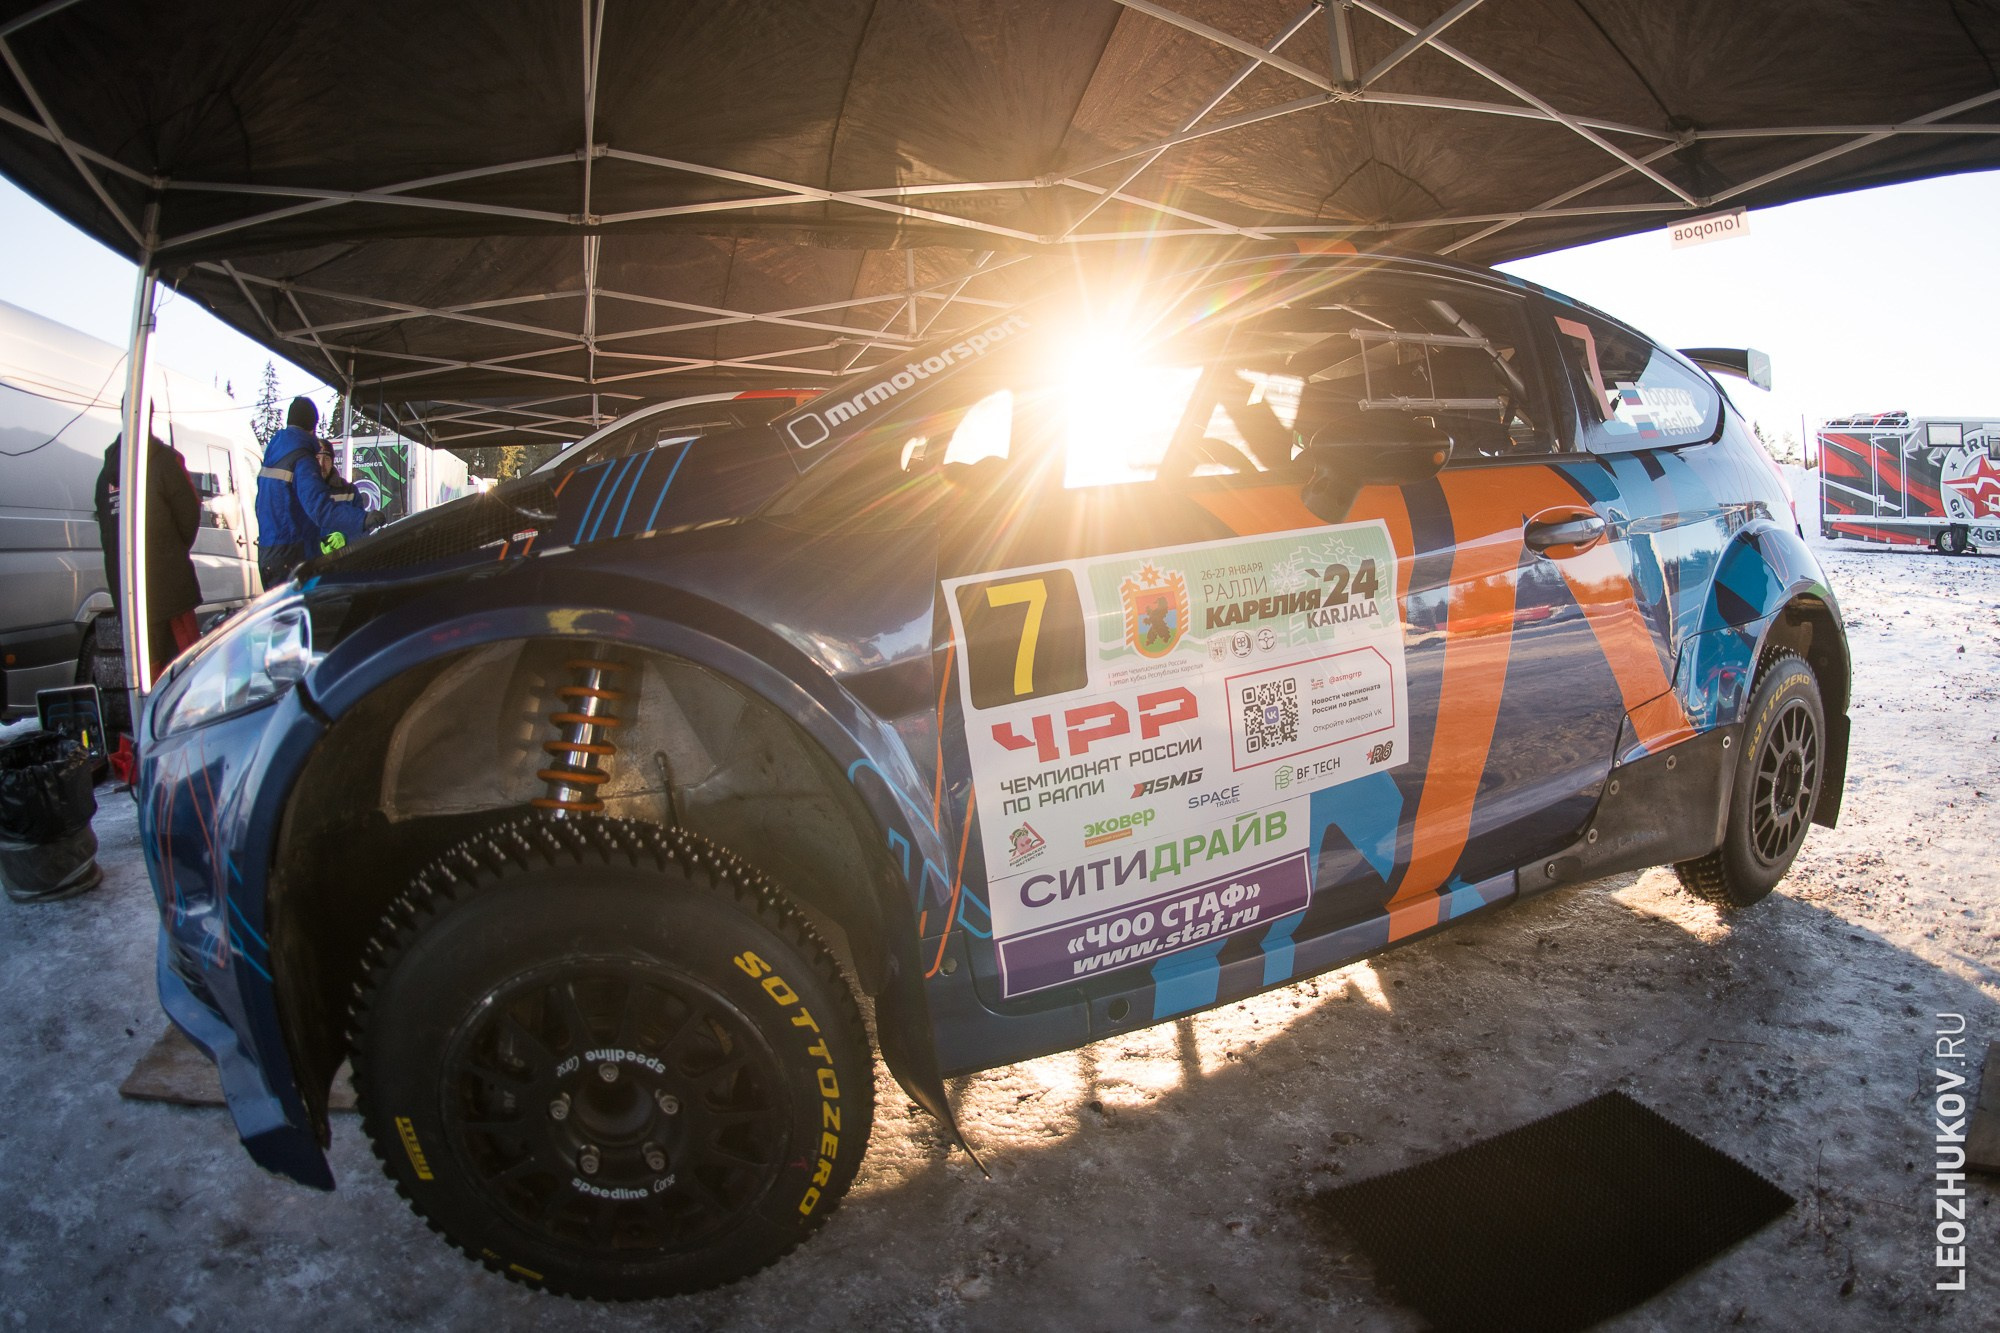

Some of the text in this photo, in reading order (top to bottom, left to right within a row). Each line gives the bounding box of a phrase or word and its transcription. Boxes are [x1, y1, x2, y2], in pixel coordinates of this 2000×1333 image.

[824, 314, 1031, 427] mrmotorsport
[1554, 316, 1616, 421] 7
[1201, 562, 1263, 580] 26-27 ЯНВАРЯ
[1204, 576, 1268, 603] РАЛЛИ
[1206, 589, 1321, 629] КАРЕЛИЯ
[1307, 601, 1379, 629] KARJALA
[986, 579, 1048, 695] 7
[1328, 671, 1362, 684] @asmgrrp
[1311, 684, 1381, 705] Новости чемпионата
[1312, 703, 1337, 715] России
[1348, 696, 1368, 707] ралли
[991, 686, 1199, 763] ЧРР
[1313, 719, 1344, 732] Откройте
[1345, 711, 1372, 723] камерой
[1748, 674, 1811, 761] SOTTOZERO
[1000, 737, 1202, 795] ЧЕМПИОНАТ РОССИИ
[1297, 766, 1310, 780] BF
[1313, 757, 1340, 775] TECH
[1141, 768, 1203, 796] ASMG
[1003, 779, 1105, 816] ПО РАЛЛИ
[1188, 785, 1240, 809] SPACE
[1215, 797, 1240, 808] TRAVEL
[1020, 810, 1288, 908] СИТИДРАЙВ
[1067, 880, 1262, 956] «ЧОО СТАФ»
[1072, 904, 1260, 975] www.staf.ru
[557, 1049, 666, 1077] speedline Corse
[733, 949, 841, 1216] SOTTOZERO
[572, 1173, 676, 1199] speedline Corse
